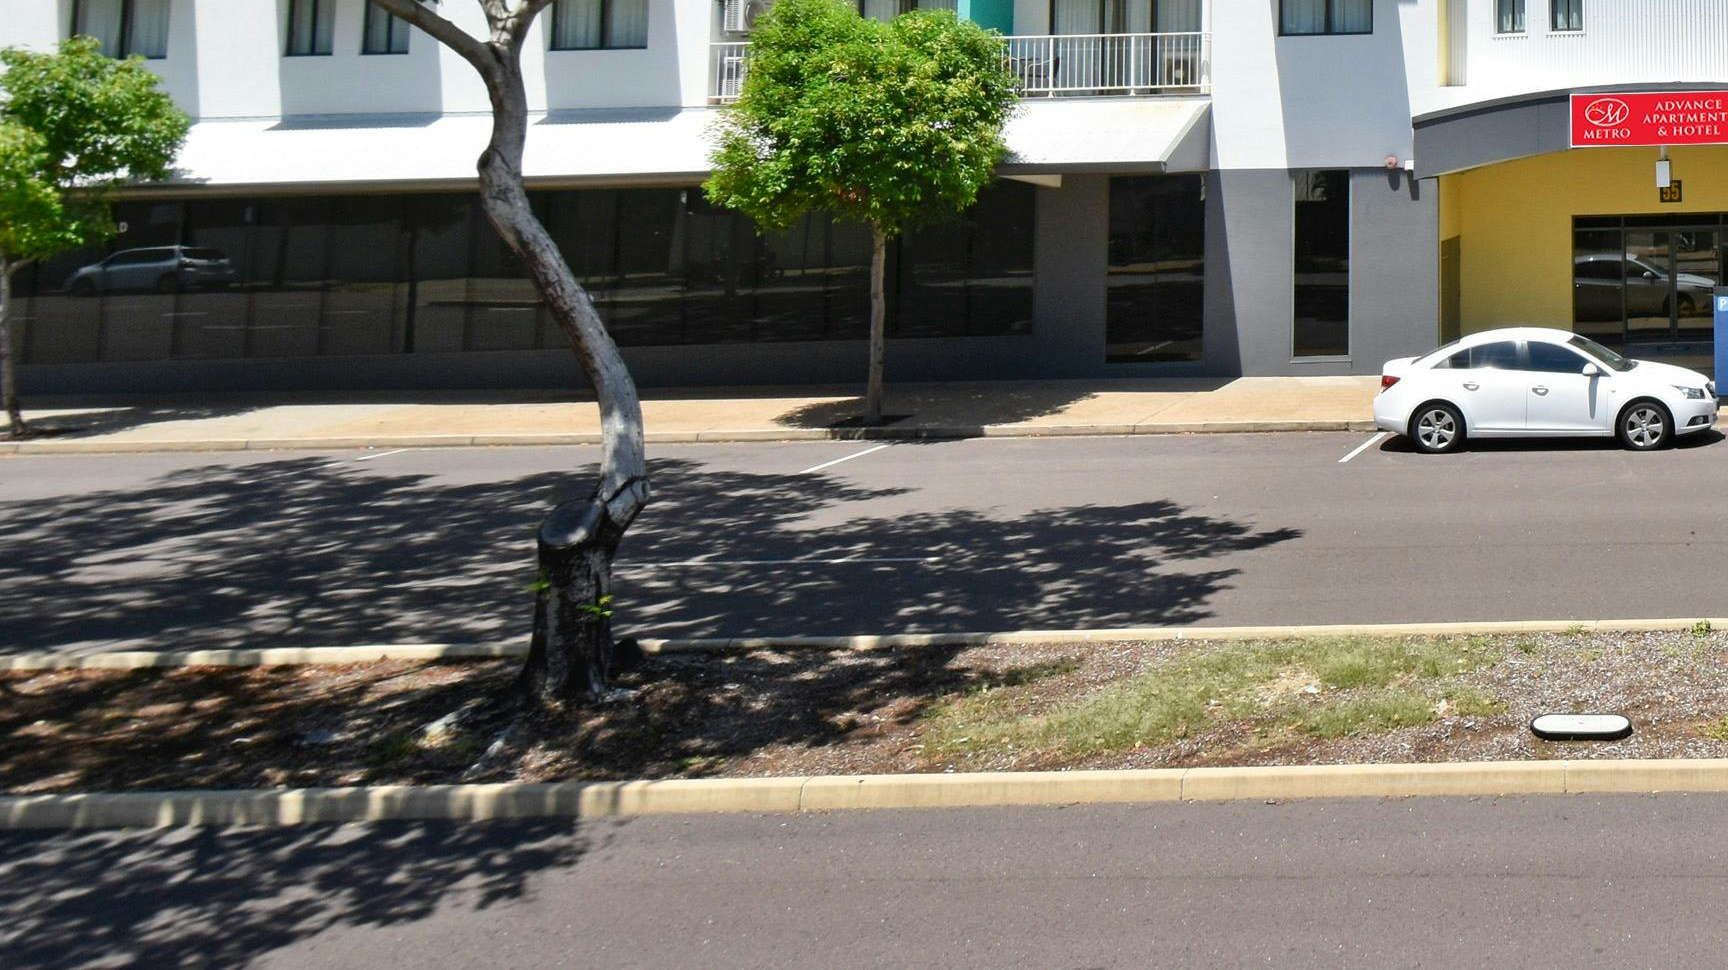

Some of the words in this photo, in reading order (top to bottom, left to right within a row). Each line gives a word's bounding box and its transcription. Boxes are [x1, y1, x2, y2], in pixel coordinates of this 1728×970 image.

[1655, 99, 1722, 111] ADVANCE
[1583, 128, 1631, 139] METRO
[1657, 126, 1668, 136] &
[1673, 125, 1721, 136] HOTEL
